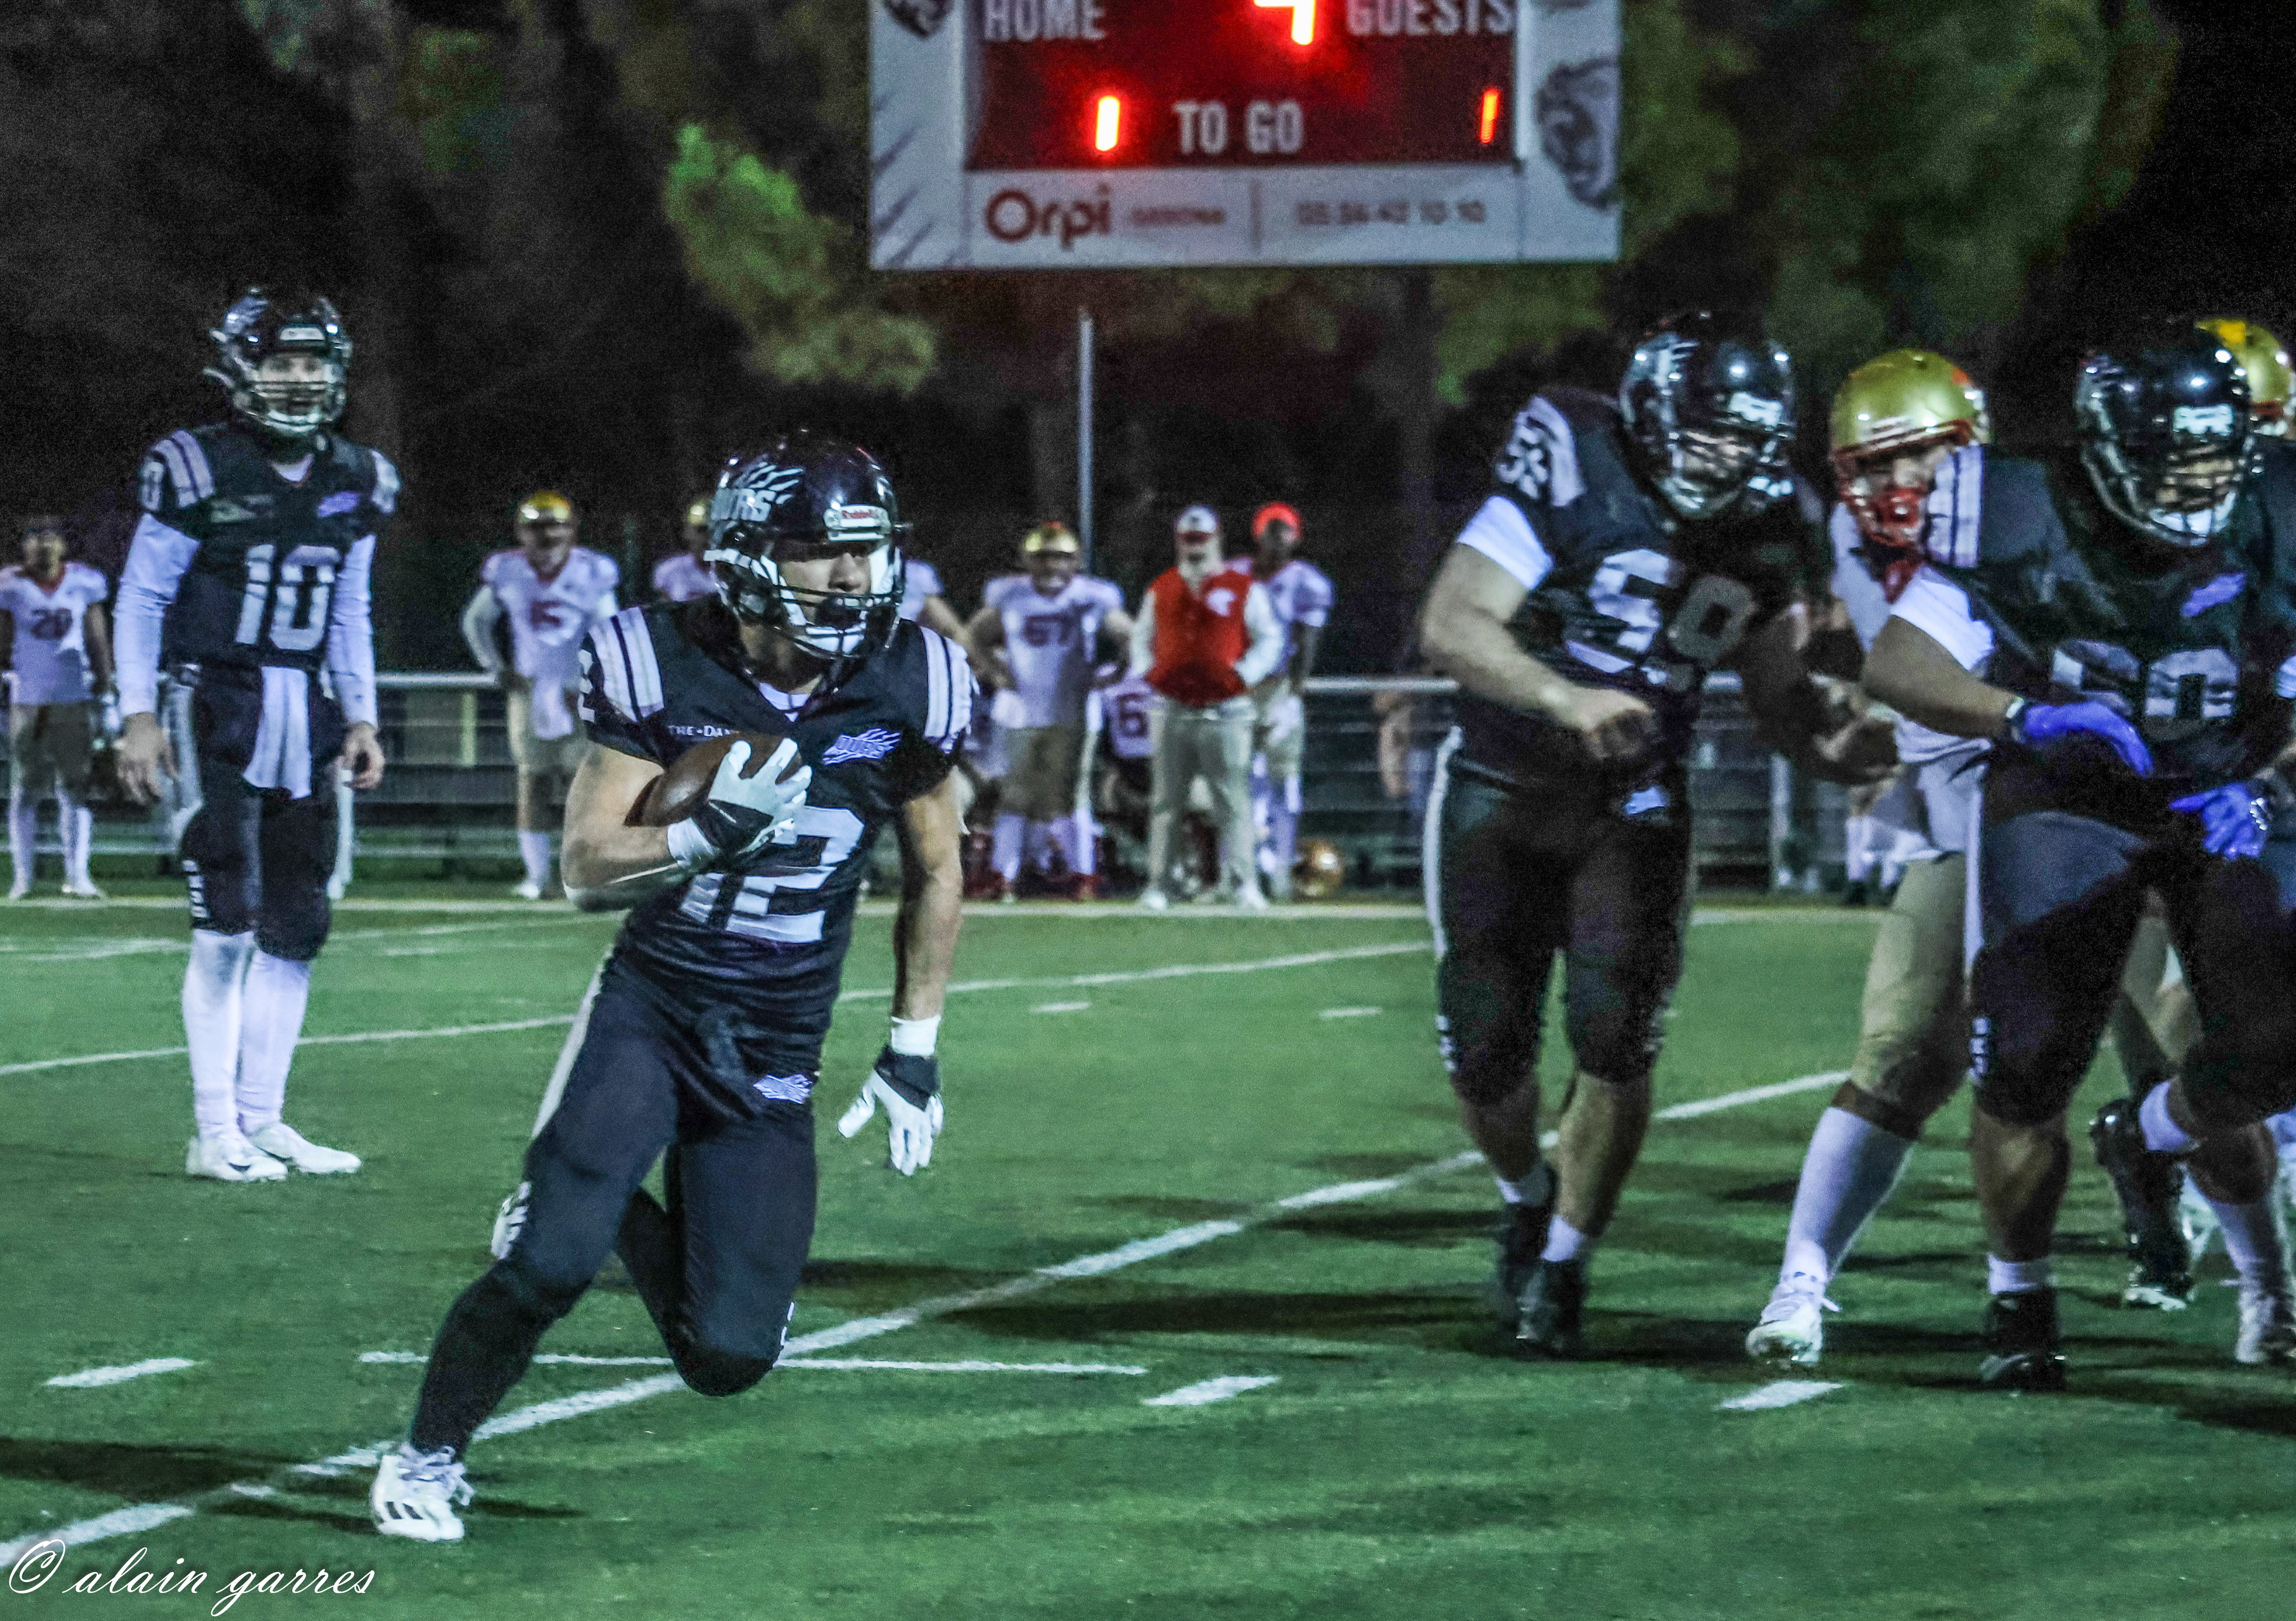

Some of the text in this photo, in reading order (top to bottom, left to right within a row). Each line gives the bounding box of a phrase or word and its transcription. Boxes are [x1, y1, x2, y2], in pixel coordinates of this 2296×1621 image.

[983, 0, 1105, 40] HOME
[1346, 0, 1513, 36] GUESTS
[1172, 100, 1304, 154] TO GO
[986, 181, 1111, 251] Orpi
[234, 544, 341, 650] 10
